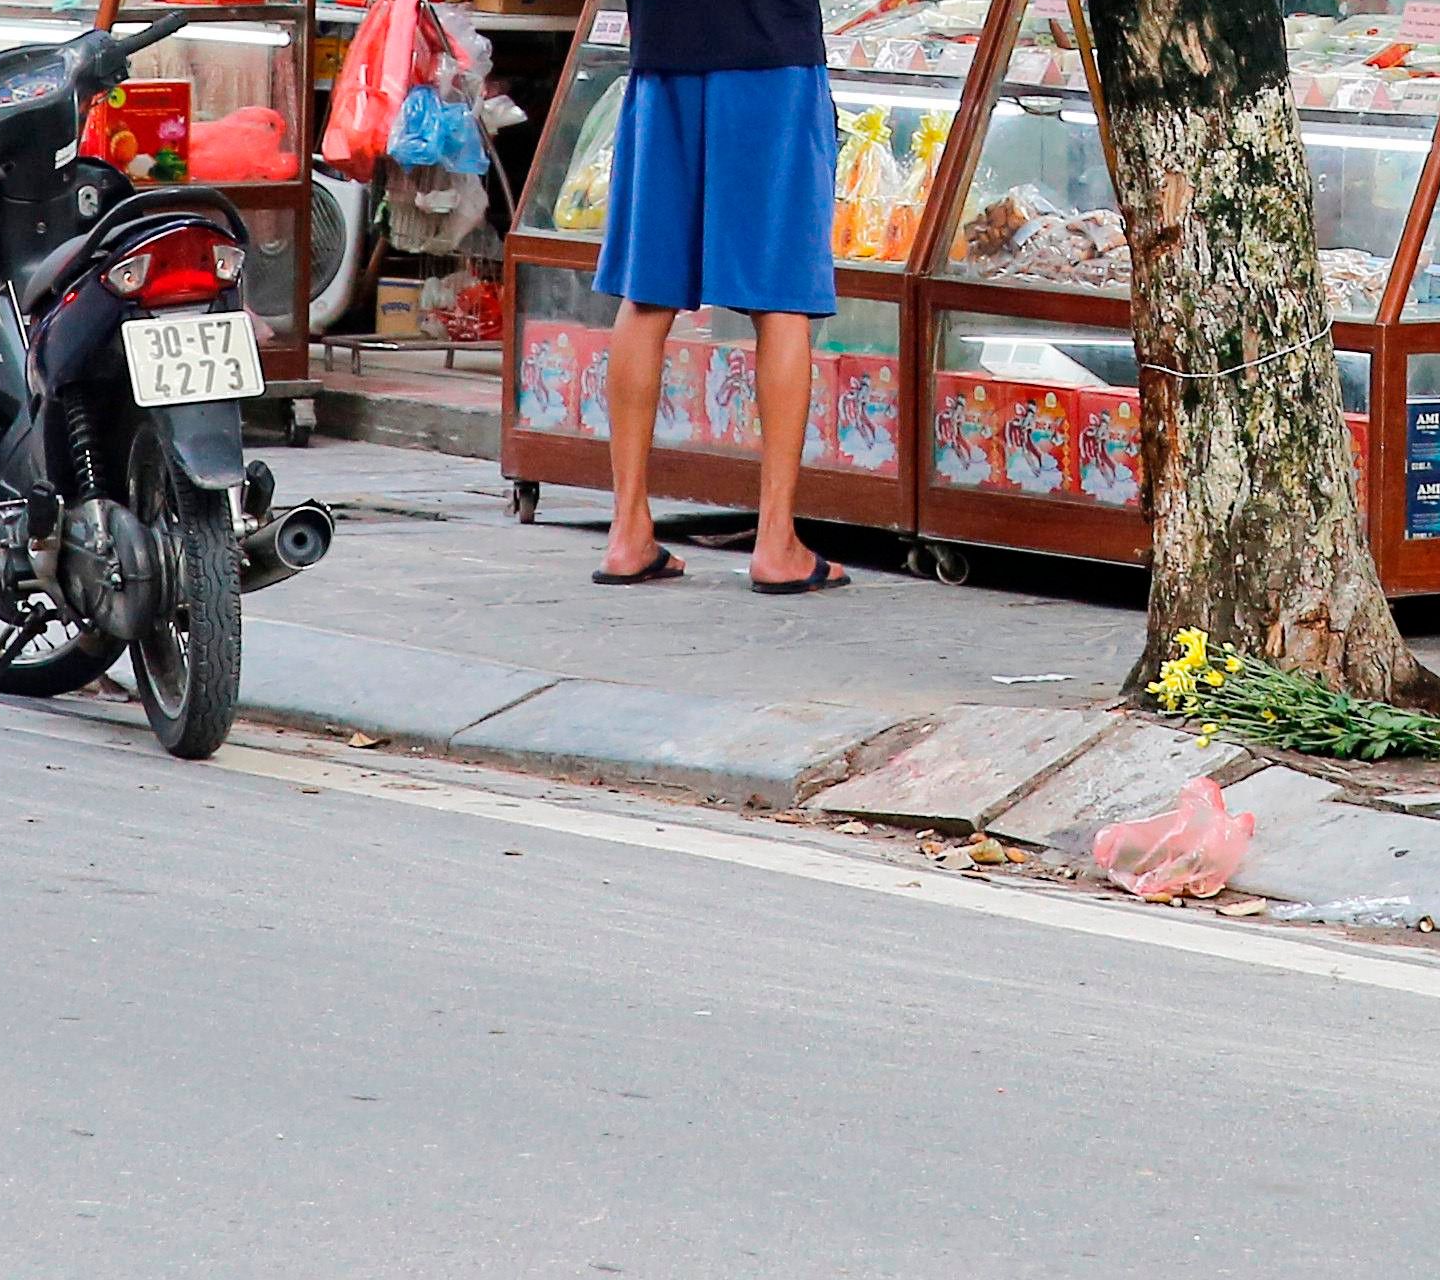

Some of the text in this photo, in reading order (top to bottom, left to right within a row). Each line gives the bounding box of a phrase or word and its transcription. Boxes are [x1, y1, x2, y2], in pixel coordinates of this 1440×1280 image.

[144, 321, 233, 360] 30-F7
[154, 357, 245, 399] 4273
[1416, 413, 1440, 425] AMI
